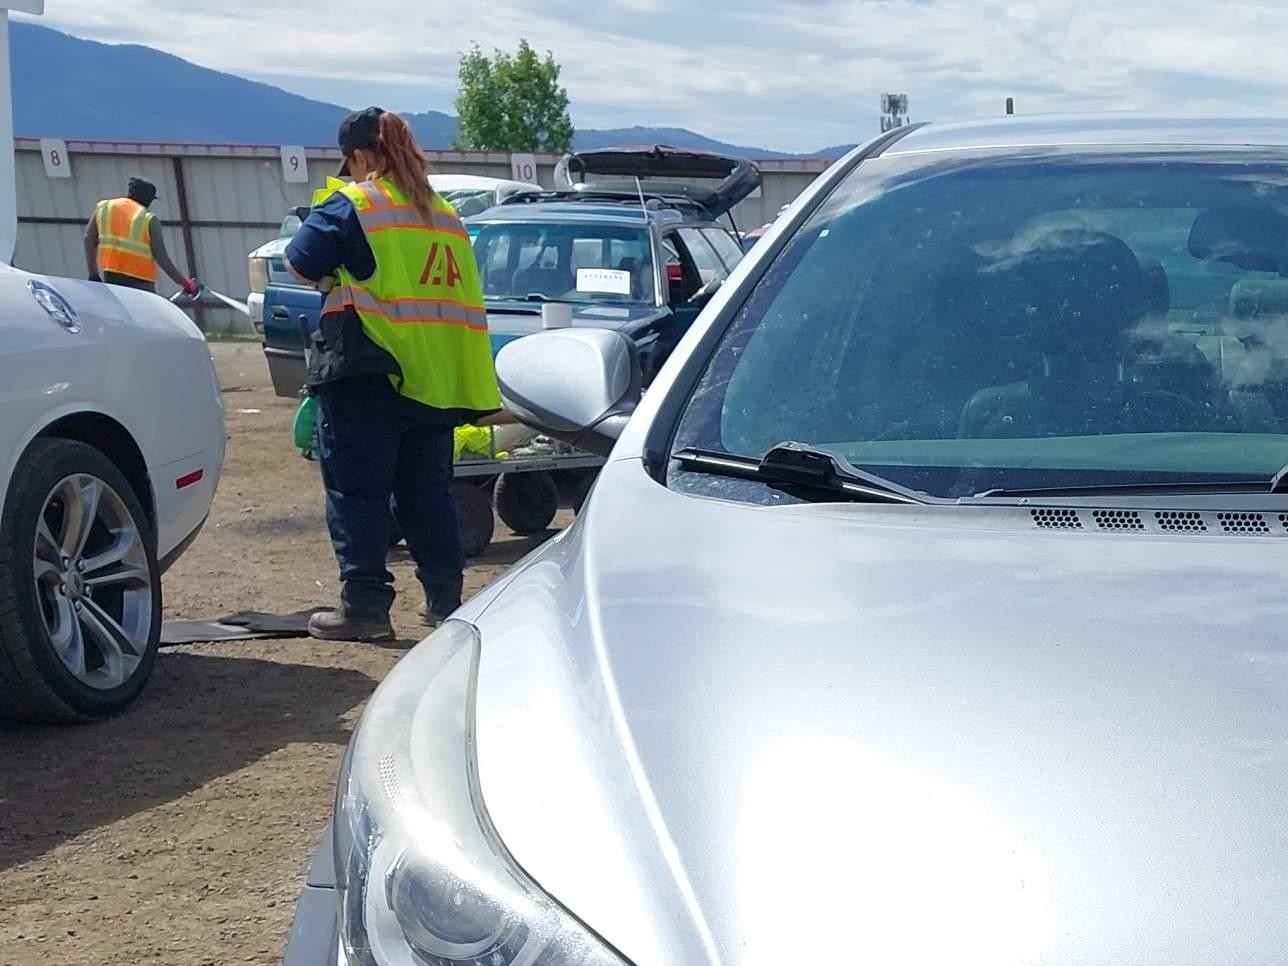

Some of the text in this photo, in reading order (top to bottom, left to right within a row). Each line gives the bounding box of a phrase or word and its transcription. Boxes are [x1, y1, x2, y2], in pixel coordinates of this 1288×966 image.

[50, 150, 61, 166] 8
[289, 155, 299, 172] 9
[516, 164, 534, 181] 10
